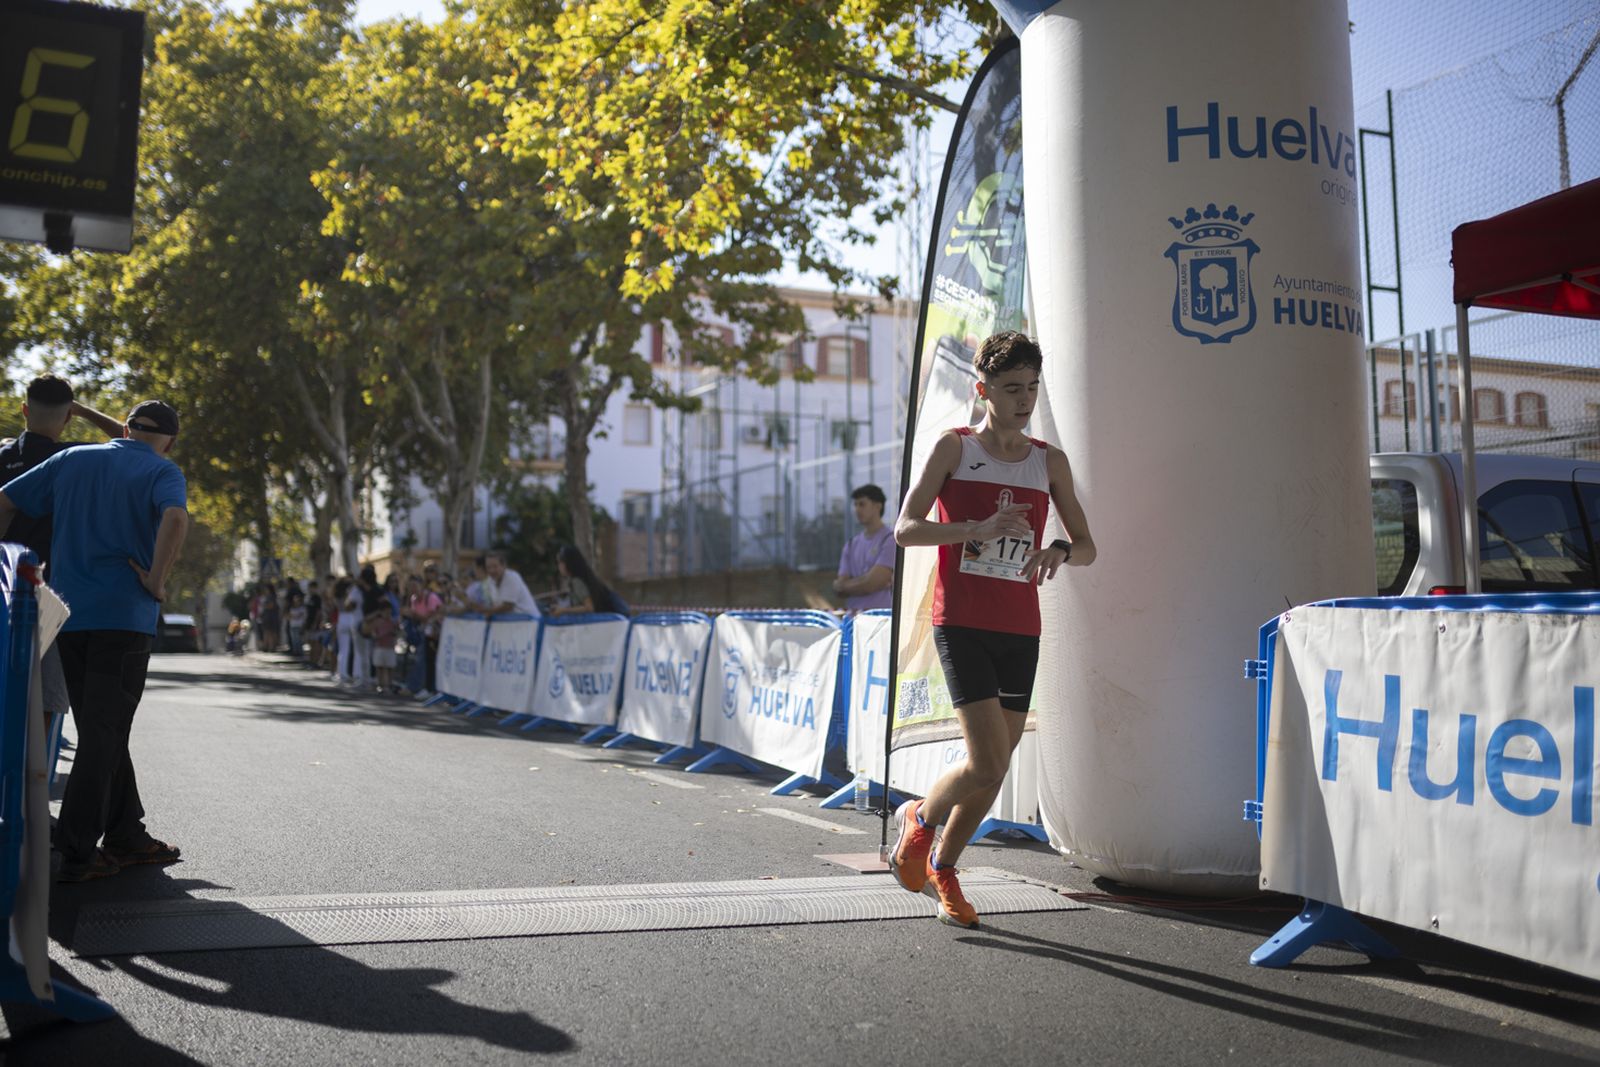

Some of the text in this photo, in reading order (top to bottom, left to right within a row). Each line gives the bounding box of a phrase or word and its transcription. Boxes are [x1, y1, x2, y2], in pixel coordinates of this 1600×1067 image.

[9, 48, 96, 162] 6
[1274, 297, 1364, 338] HUELVA
[997, 536, 1032, 562] 177
[748, 685, 816, 731] HUELVA
